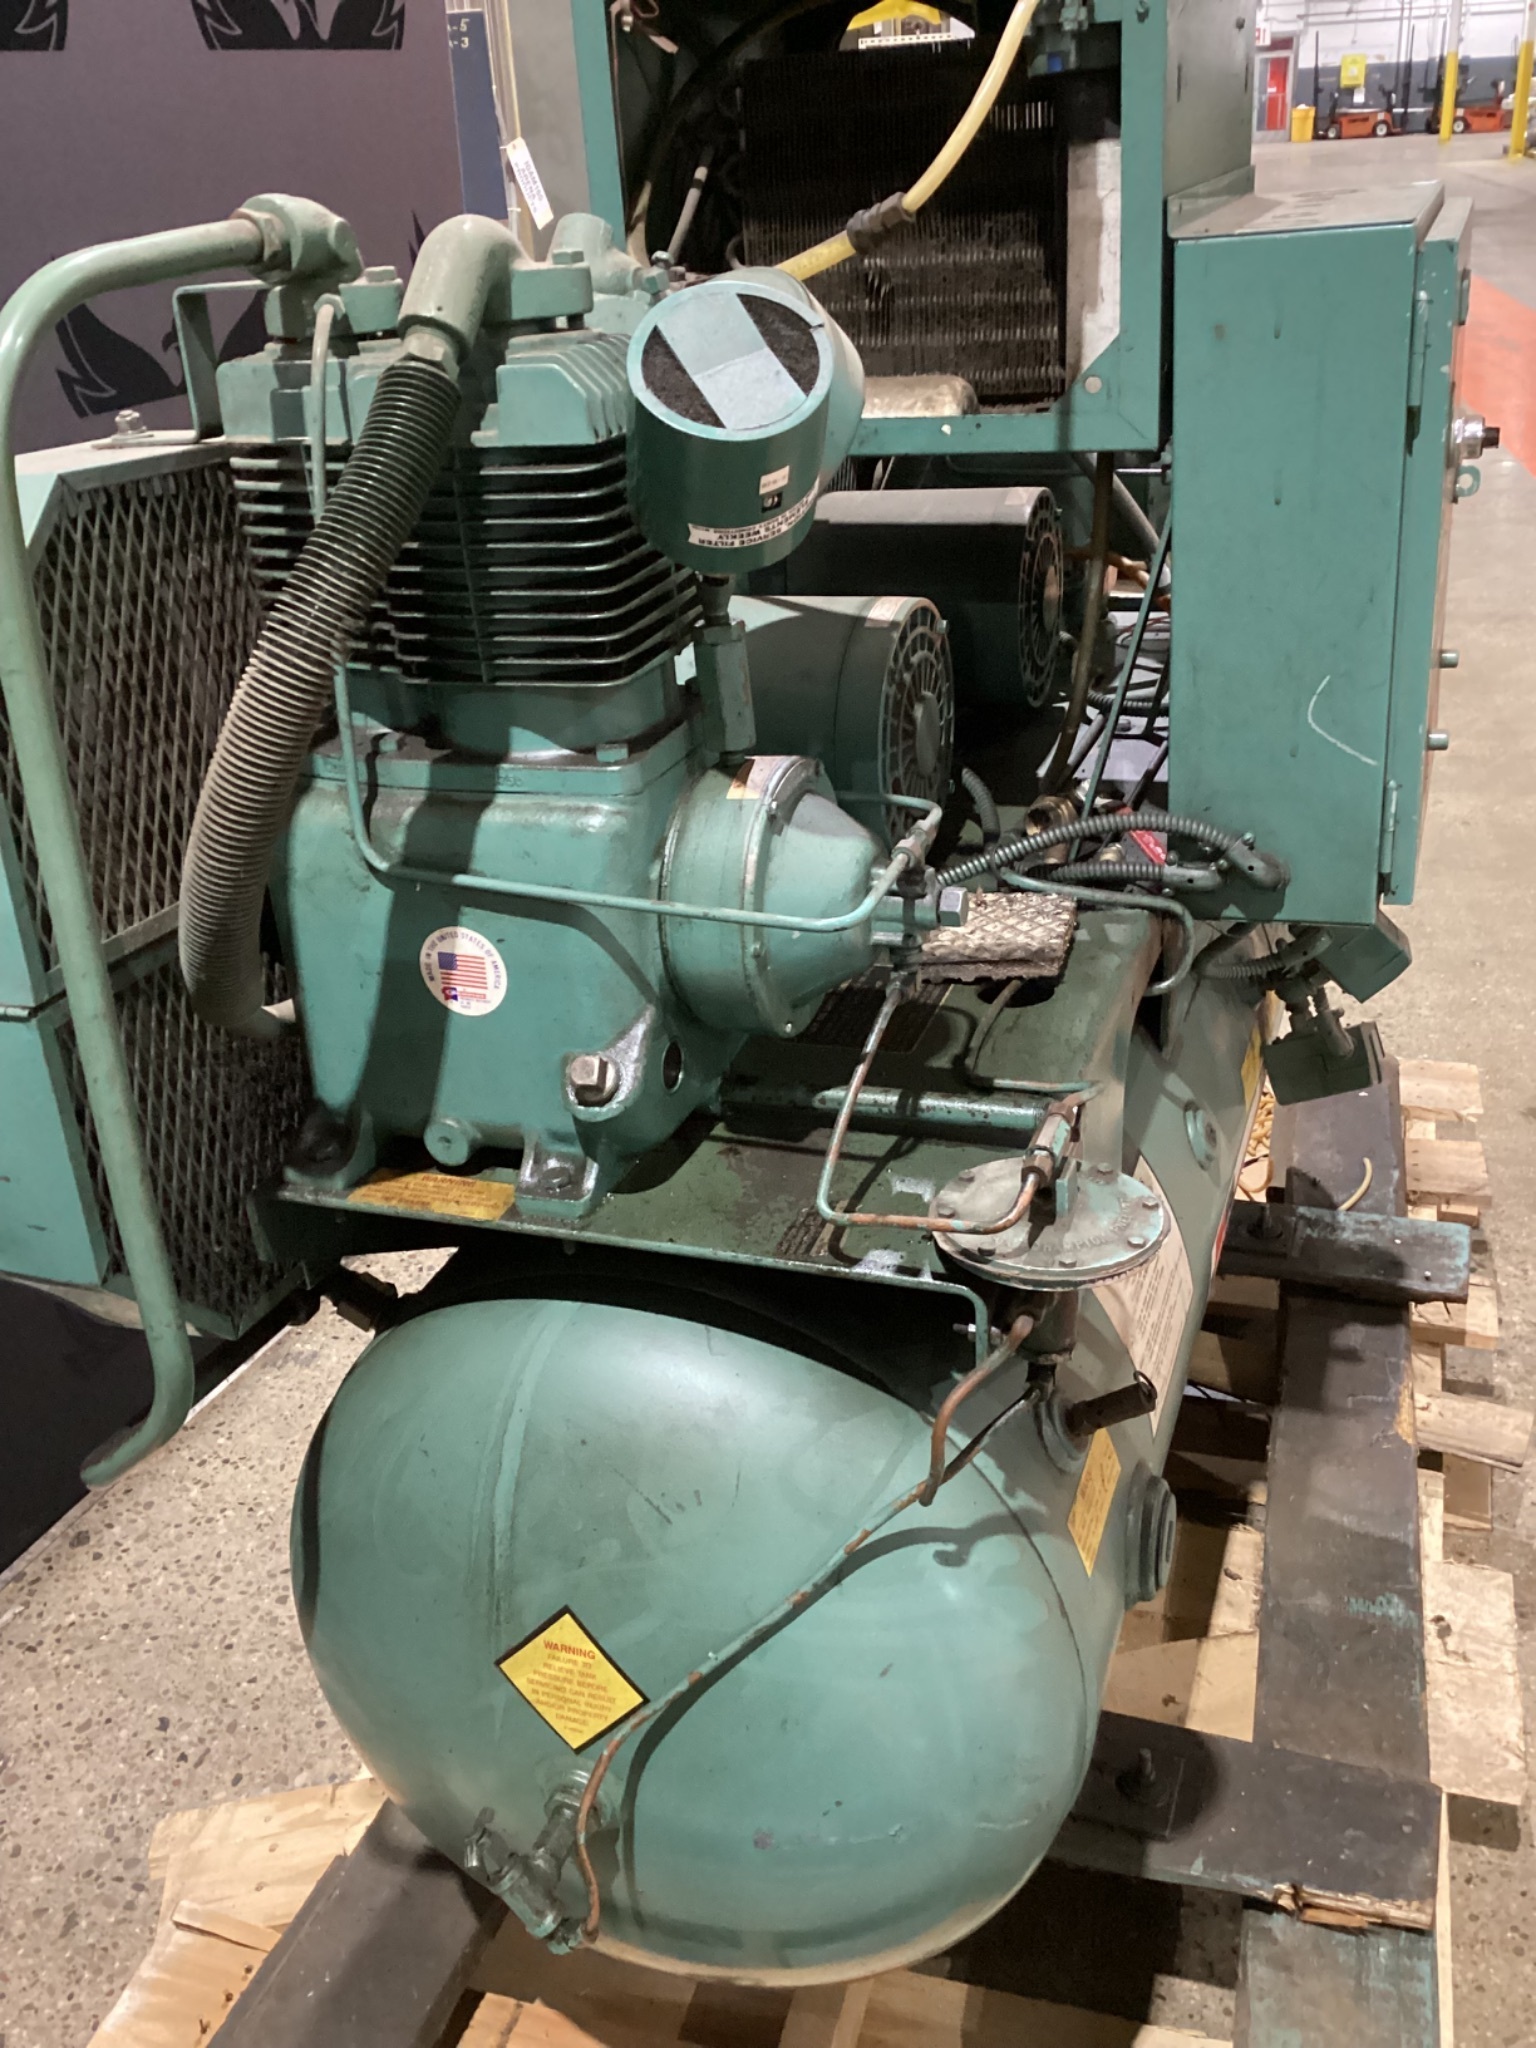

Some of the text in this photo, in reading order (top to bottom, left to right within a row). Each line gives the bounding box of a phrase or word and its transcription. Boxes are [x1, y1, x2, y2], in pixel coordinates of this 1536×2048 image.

[698, 528, 782, 547] SERVICE FILTER
[716, 530, 760, 541] WEEKLY
[436, 930, 458, 943] UNITED
[461, 932, 485, 950] STATES
[491, 960, 502, 990] AMERICA
[543, 1640, 596, 1660] WARNING
[547, 1653, 592, 1670] FAILURE TO
[533, 1670, 574, 1686] PRESSURE
[542, 1662, 597, 1680] RELIEVE TANK
[526, 1678, 567, 1694] SERVICING
[588, 1692, 616, 1705] RESULT
[541, 1690, 582, 1706] PERSONAL
[584, 1700, 612, 1712] INJURY
[567, 1705, 608, 1721] PROPERTY
